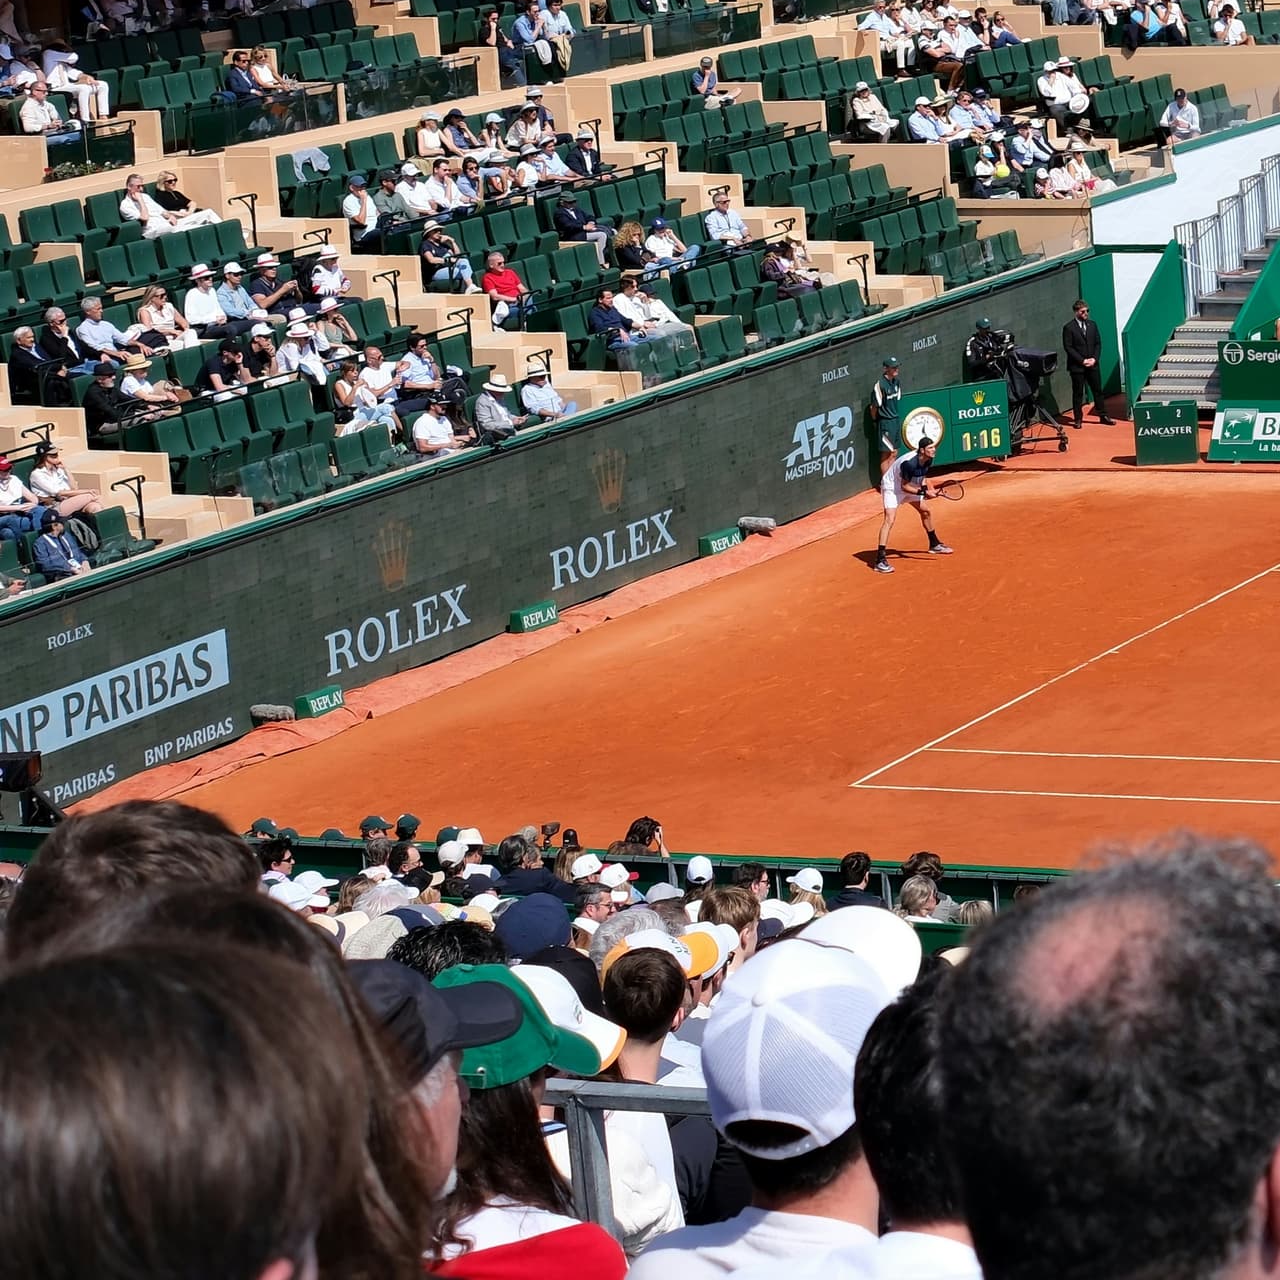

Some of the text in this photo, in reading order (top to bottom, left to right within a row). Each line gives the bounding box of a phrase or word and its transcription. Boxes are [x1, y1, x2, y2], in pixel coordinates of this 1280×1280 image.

[912, 334, 938, 352] ROLEX
[822, 365, 849, 384] ROLEX
[958, 404, 1002, 420] ROLEX
[780, 405, 853, 468] ATP
[962, 427, 1001, 452] 1:16
[1137, 424, 1193, 438] LANCASTER
[1258, 442, 1269, 452] La
[784, 446, 856, 483] MASTERS 1000
[550, 508, 677, 591] ROLEX
[711, 531, 741, 553] REPLAY
[523, 604, 557, 629] REPLAY
[47, 623, 93, 650] ROLEX
[324, 583, 471, 678] ROLEX
[0, 641, 212, 753] NP PARIBAS
[310, 689, 344, 714] REPLAY
[144, 716, 234, 767] BNP PARIBAS
[53, 763, 116, 804] PARIBAS
